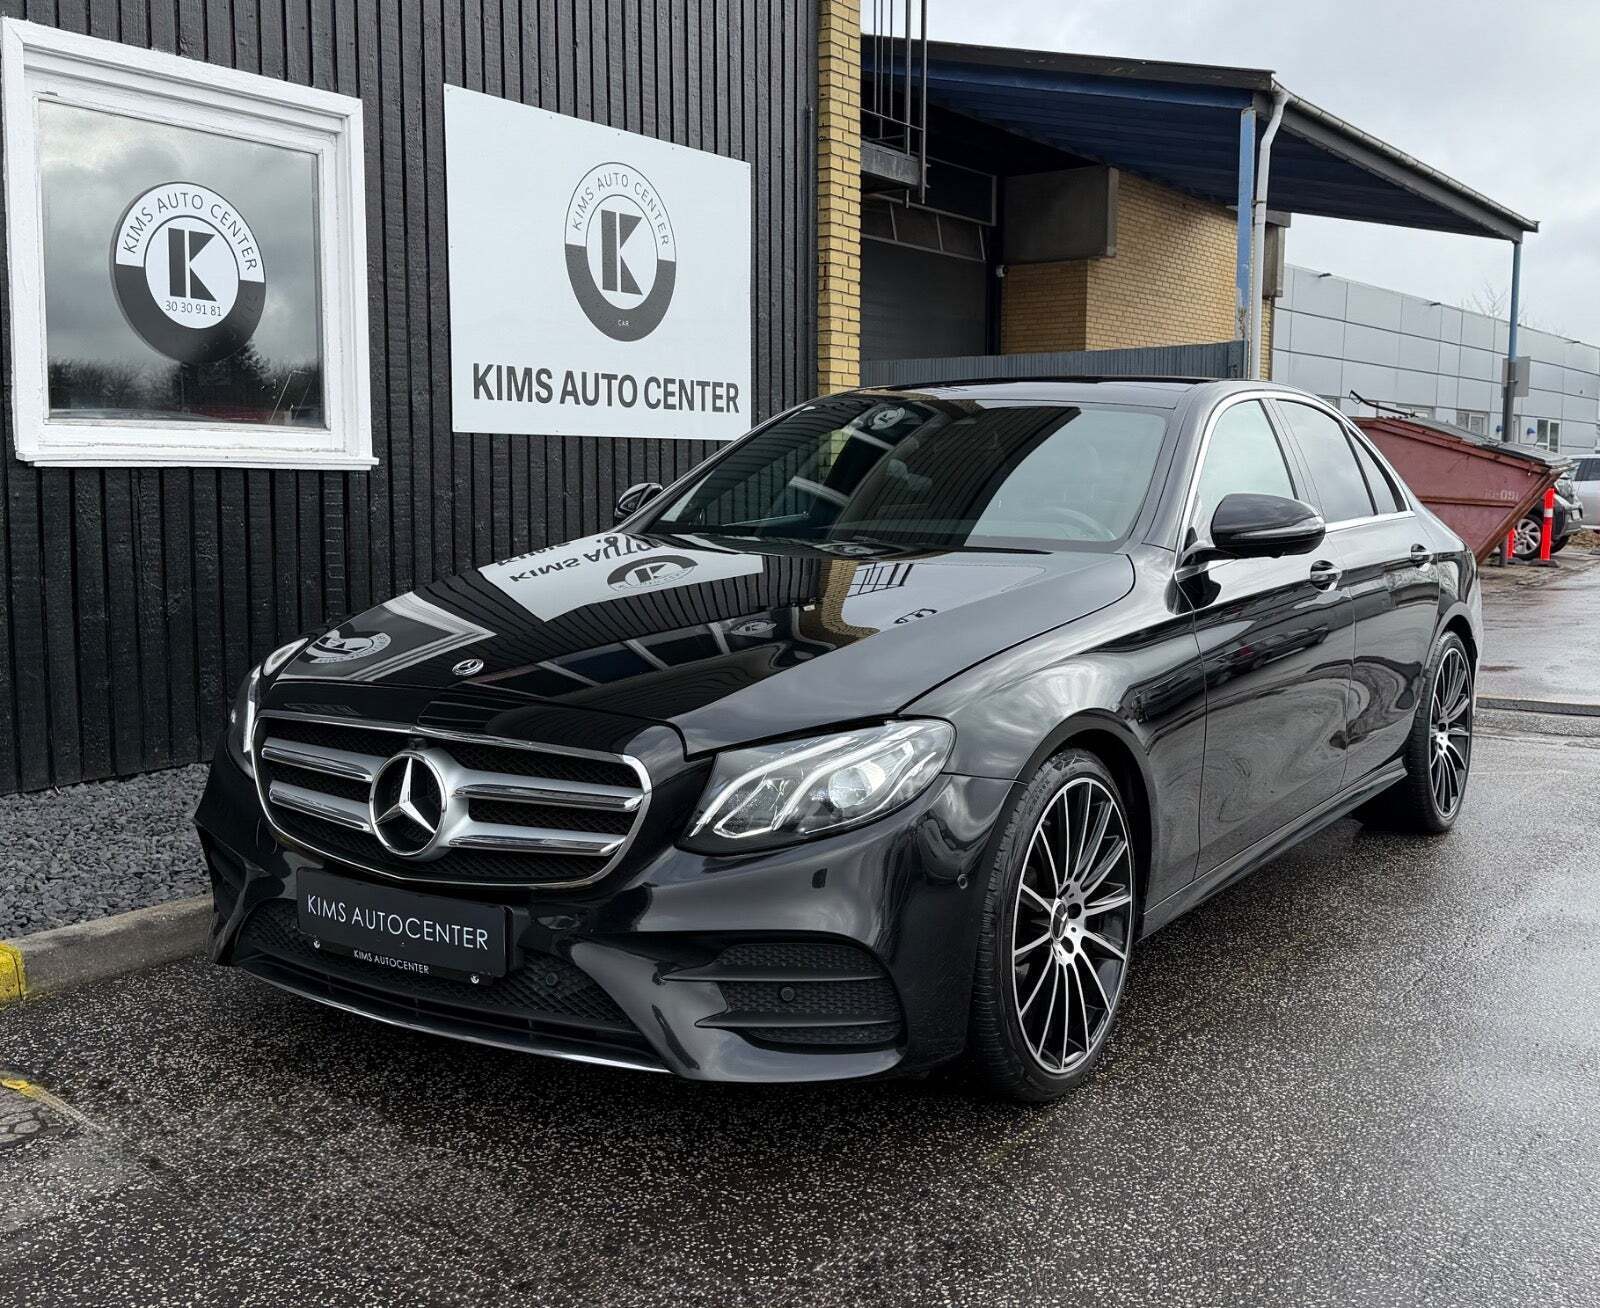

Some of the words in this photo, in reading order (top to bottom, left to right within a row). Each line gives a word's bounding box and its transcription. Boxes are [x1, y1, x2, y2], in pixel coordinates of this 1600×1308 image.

[123, 207, 154, 254] KIMS
[157, 192, 203, 214] AUTO
[210, 204, 258, 270] CENTER
[572, 187, 595, 231] KIMS
[597, 172, 629, 191] AUTO
[634, 183, 669, 246] CENTER
[168, 227, 217, 302] K
[601, 209, 643, 296] K
[165, 301, 178, 312] 30
[181, 302, 193, 313] 30
[195, 303, 208, 315] 91
[210, 306, 222, 317] 81
[473, 362, 553, 404] KIMS
[559, 370, 638, 408] AUTO
[644, 376, 740, 414] CENTER
[307, 894, 347, 923] KIMS
[351, 907, 489, 951] AUTOCENTER
[353, 950, 373, 963] KIMS
[373, 954, 430, 975] AUTOCENTER
